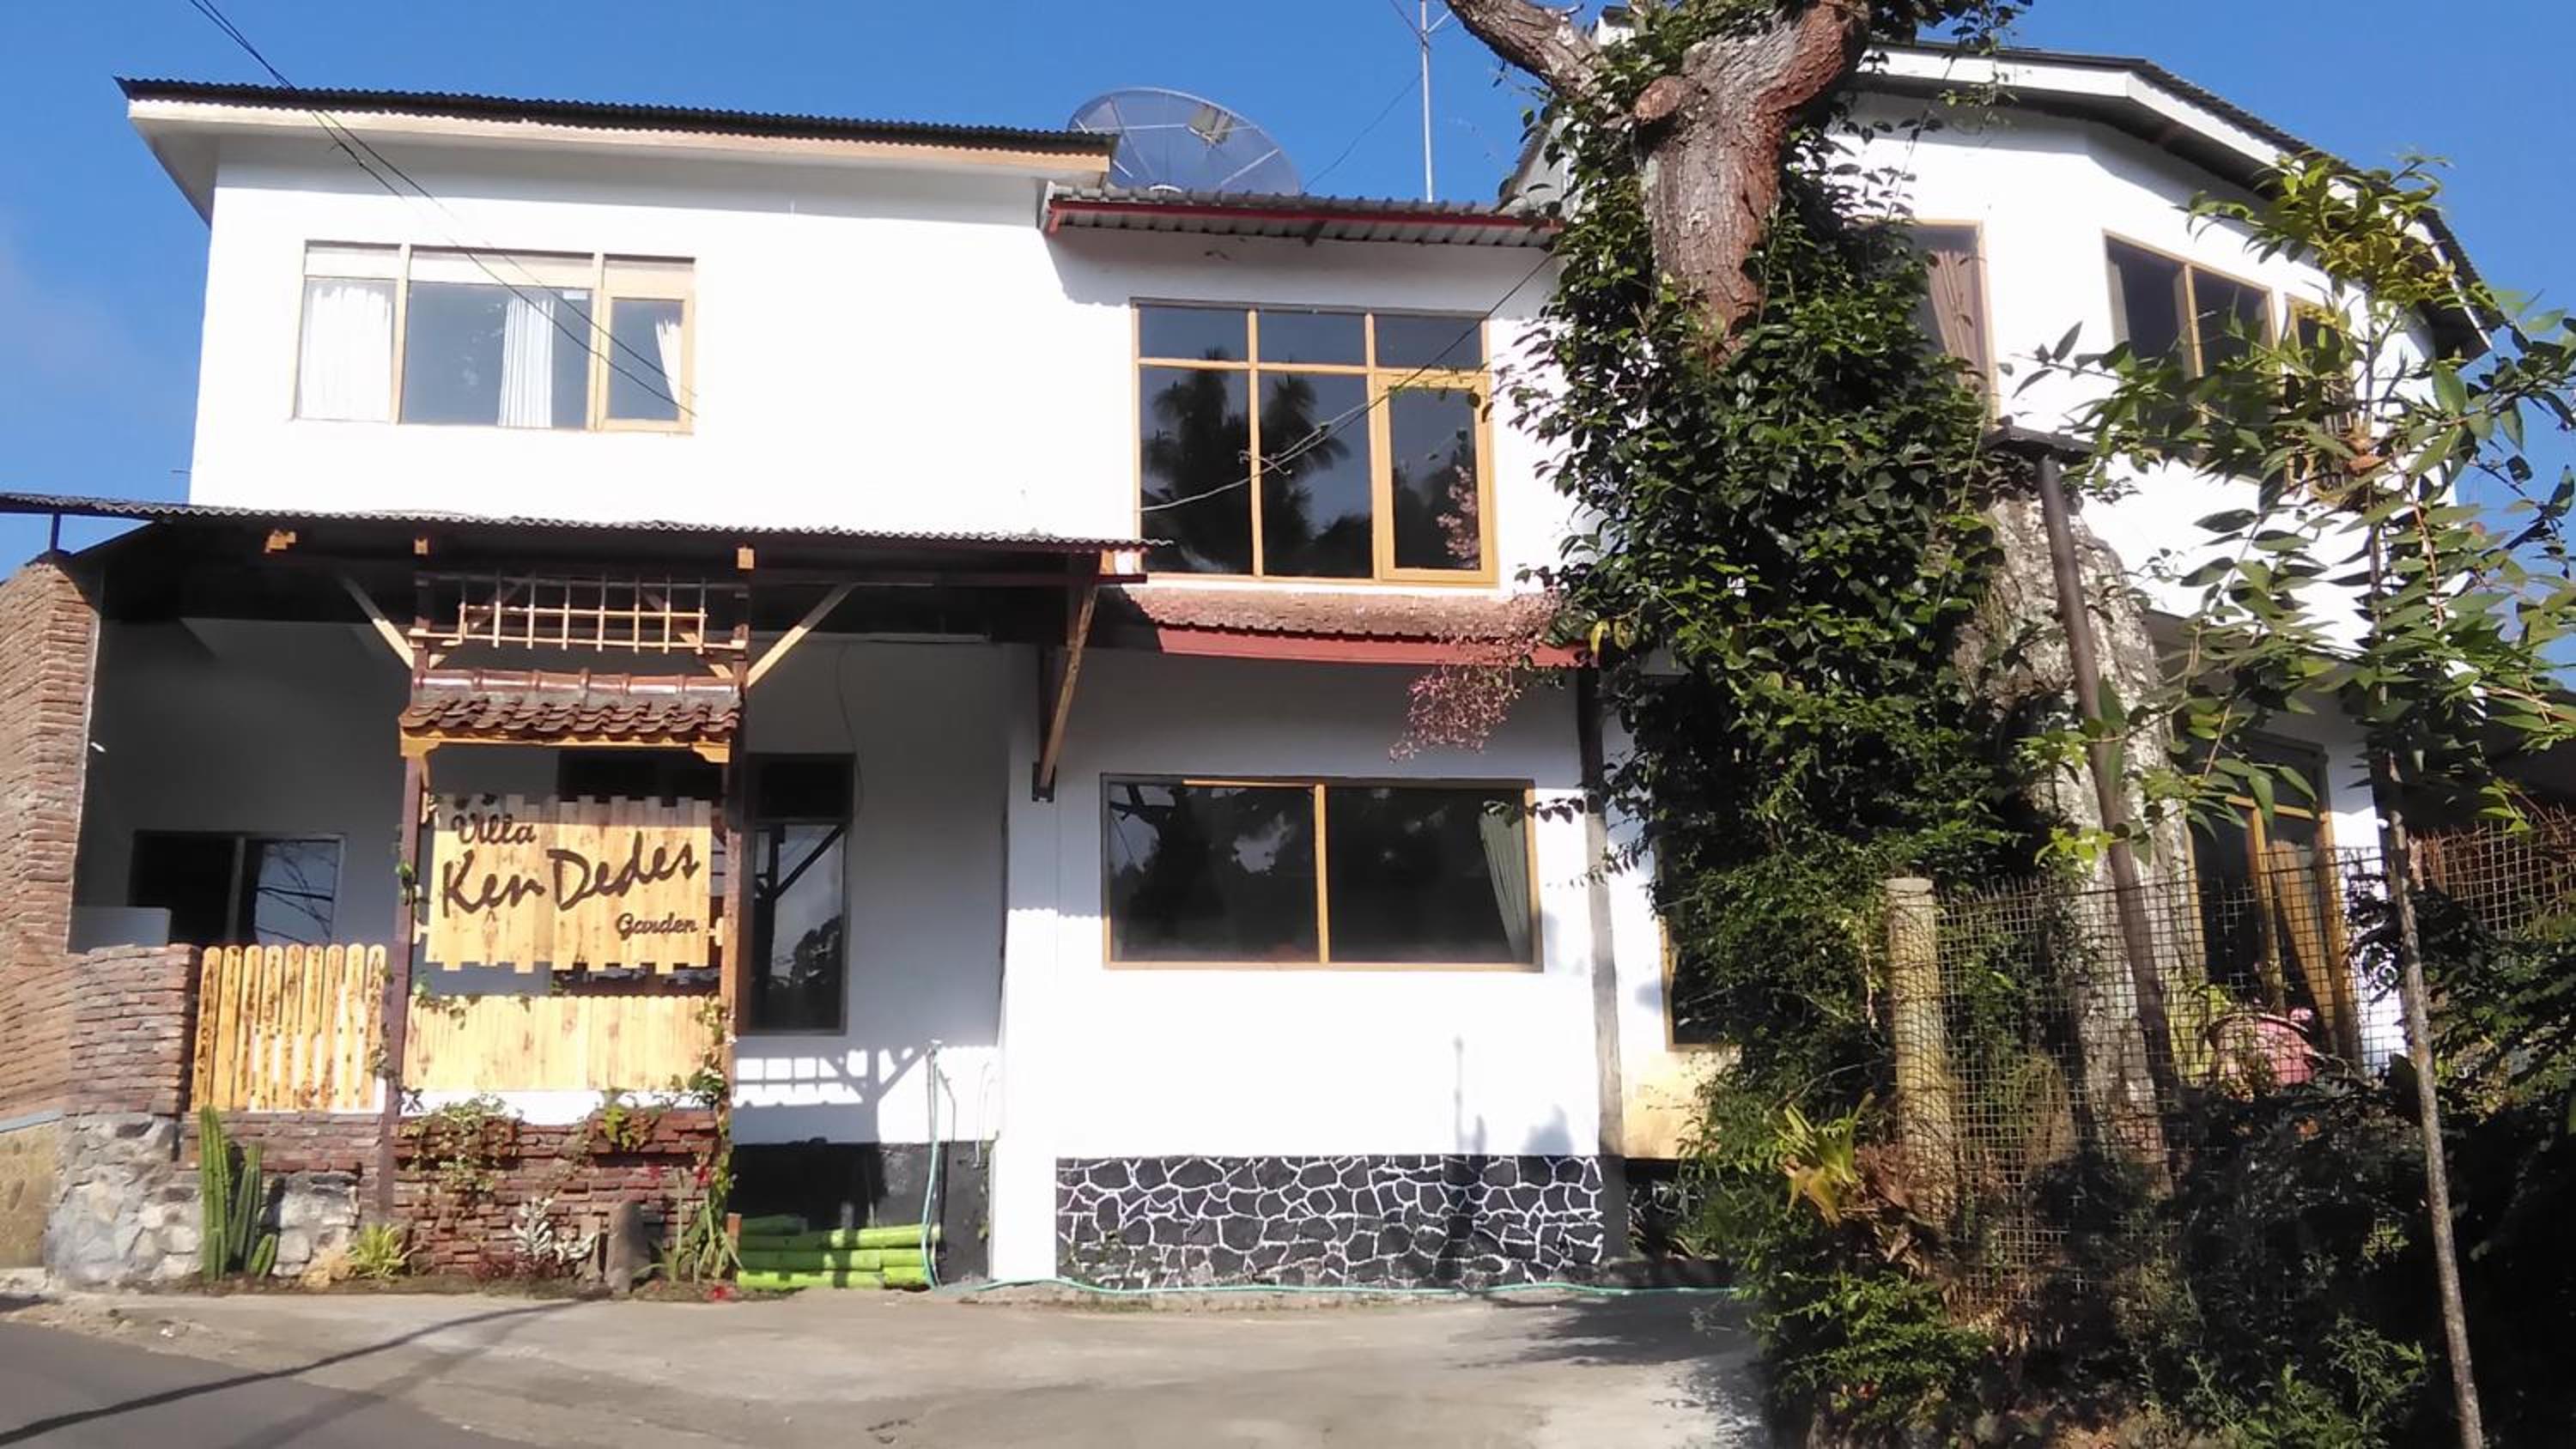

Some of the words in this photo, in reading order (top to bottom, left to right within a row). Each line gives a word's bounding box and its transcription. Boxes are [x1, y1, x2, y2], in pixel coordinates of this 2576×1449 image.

[453, 813, 537, 845] Villa
[442, 849, 546, 919] Ken
[546, 831, 701, 911] Dedes
[616, 912, 697, 940] Garden
